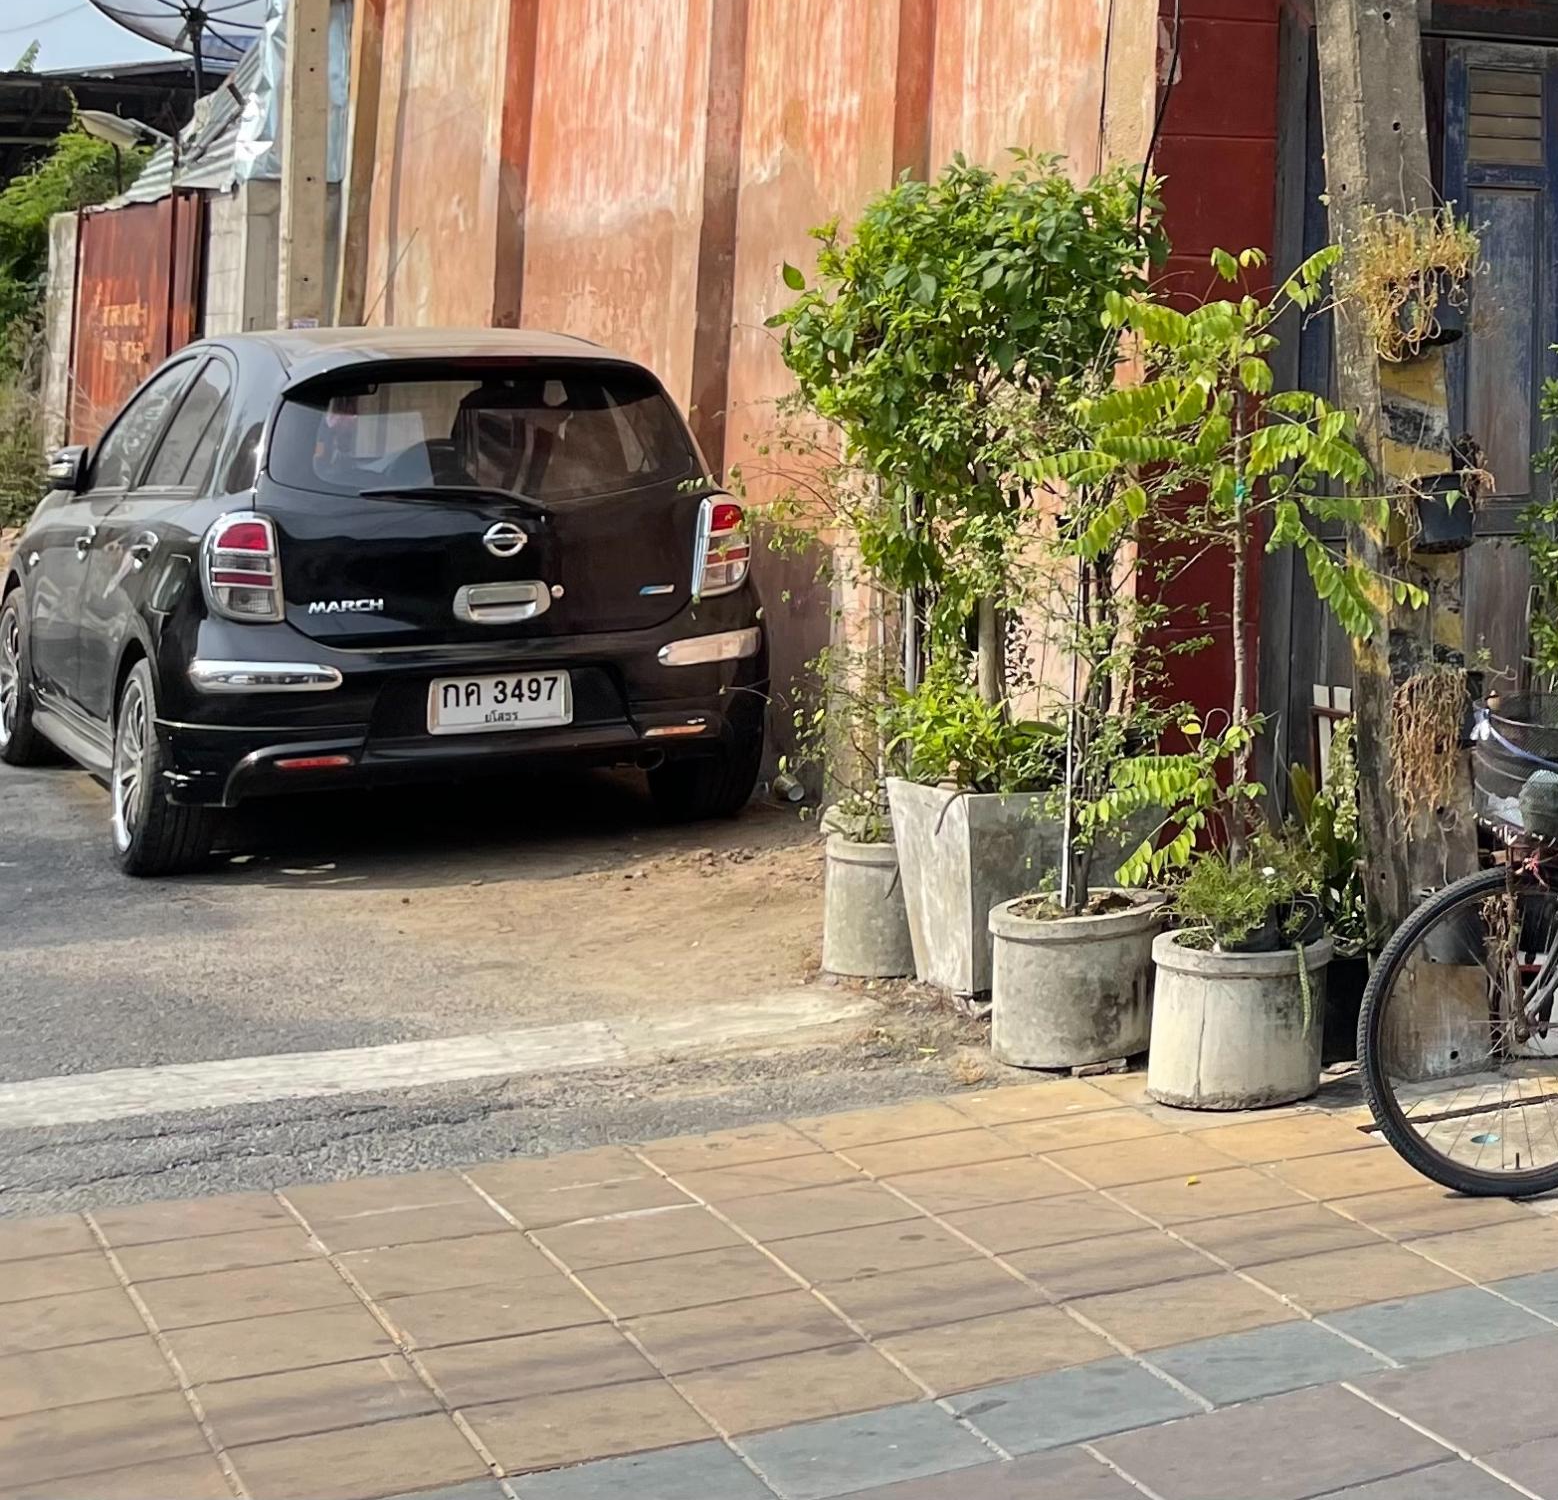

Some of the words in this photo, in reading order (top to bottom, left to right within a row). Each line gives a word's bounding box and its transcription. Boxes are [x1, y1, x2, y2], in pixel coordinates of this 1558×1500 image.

[308, 598, 384, 614] MARCH
[443, 682, 481, 708] กค
[493, 676, 559, 704] 3497
